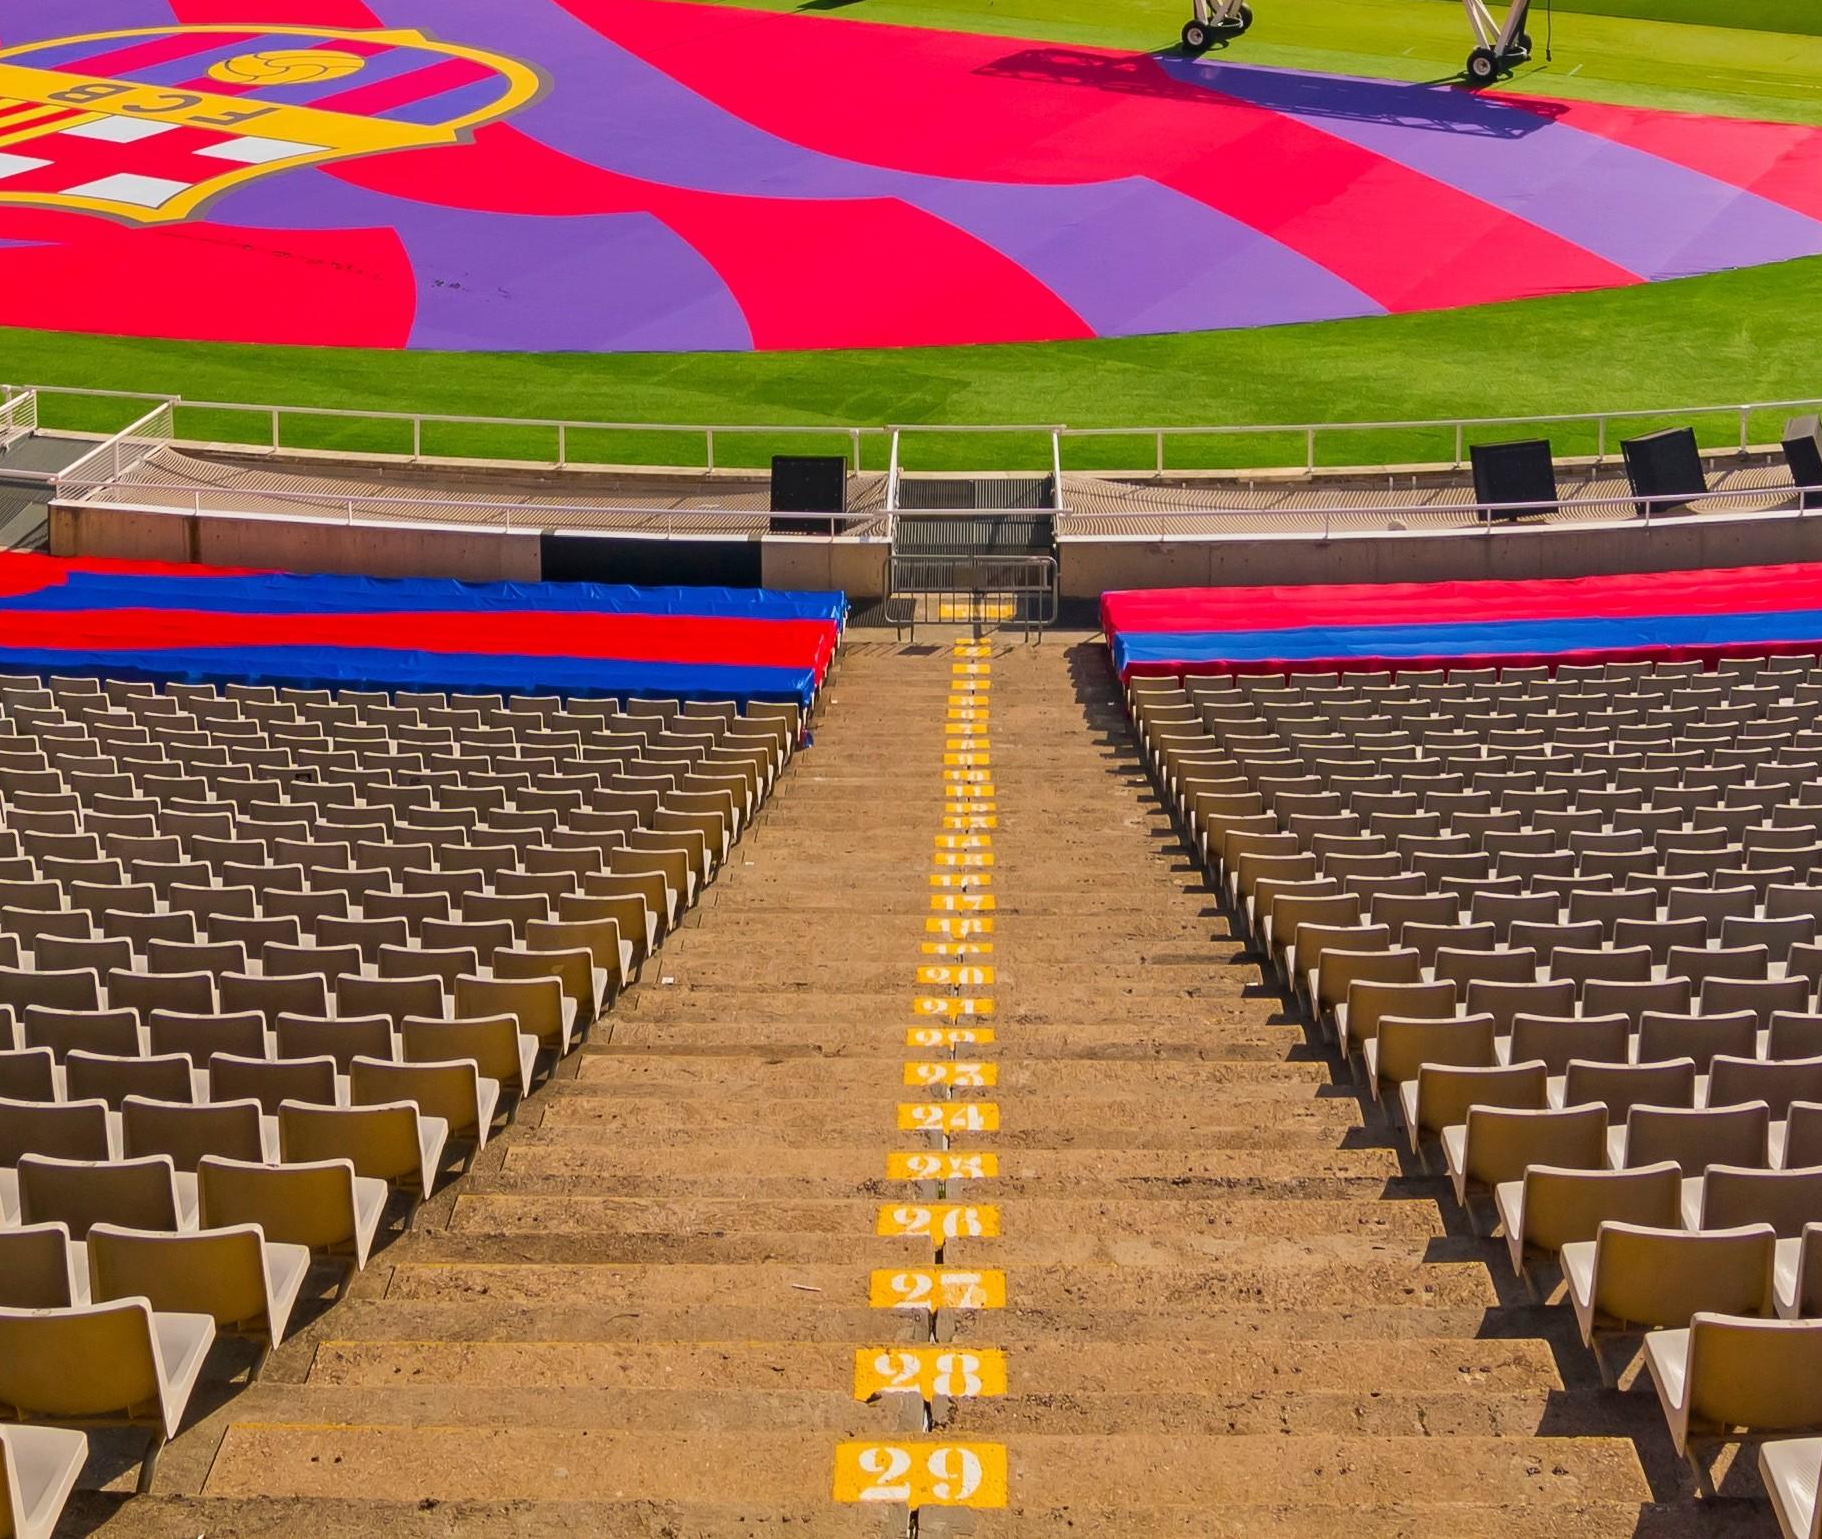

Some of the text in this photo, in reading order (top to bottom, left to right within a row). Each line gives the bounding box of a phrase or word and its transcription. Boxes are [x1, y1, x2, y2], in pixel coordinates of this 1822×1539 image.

[944, 895, 983, 910] 17
[912, 1105, 984, 1130] 24
[893, 1207, 982, 1236] 26
[891, 1273, 983, 1309] 27
[874, 1353, 982, 1397] 28
[858, 1447, 983, 1501] 29
